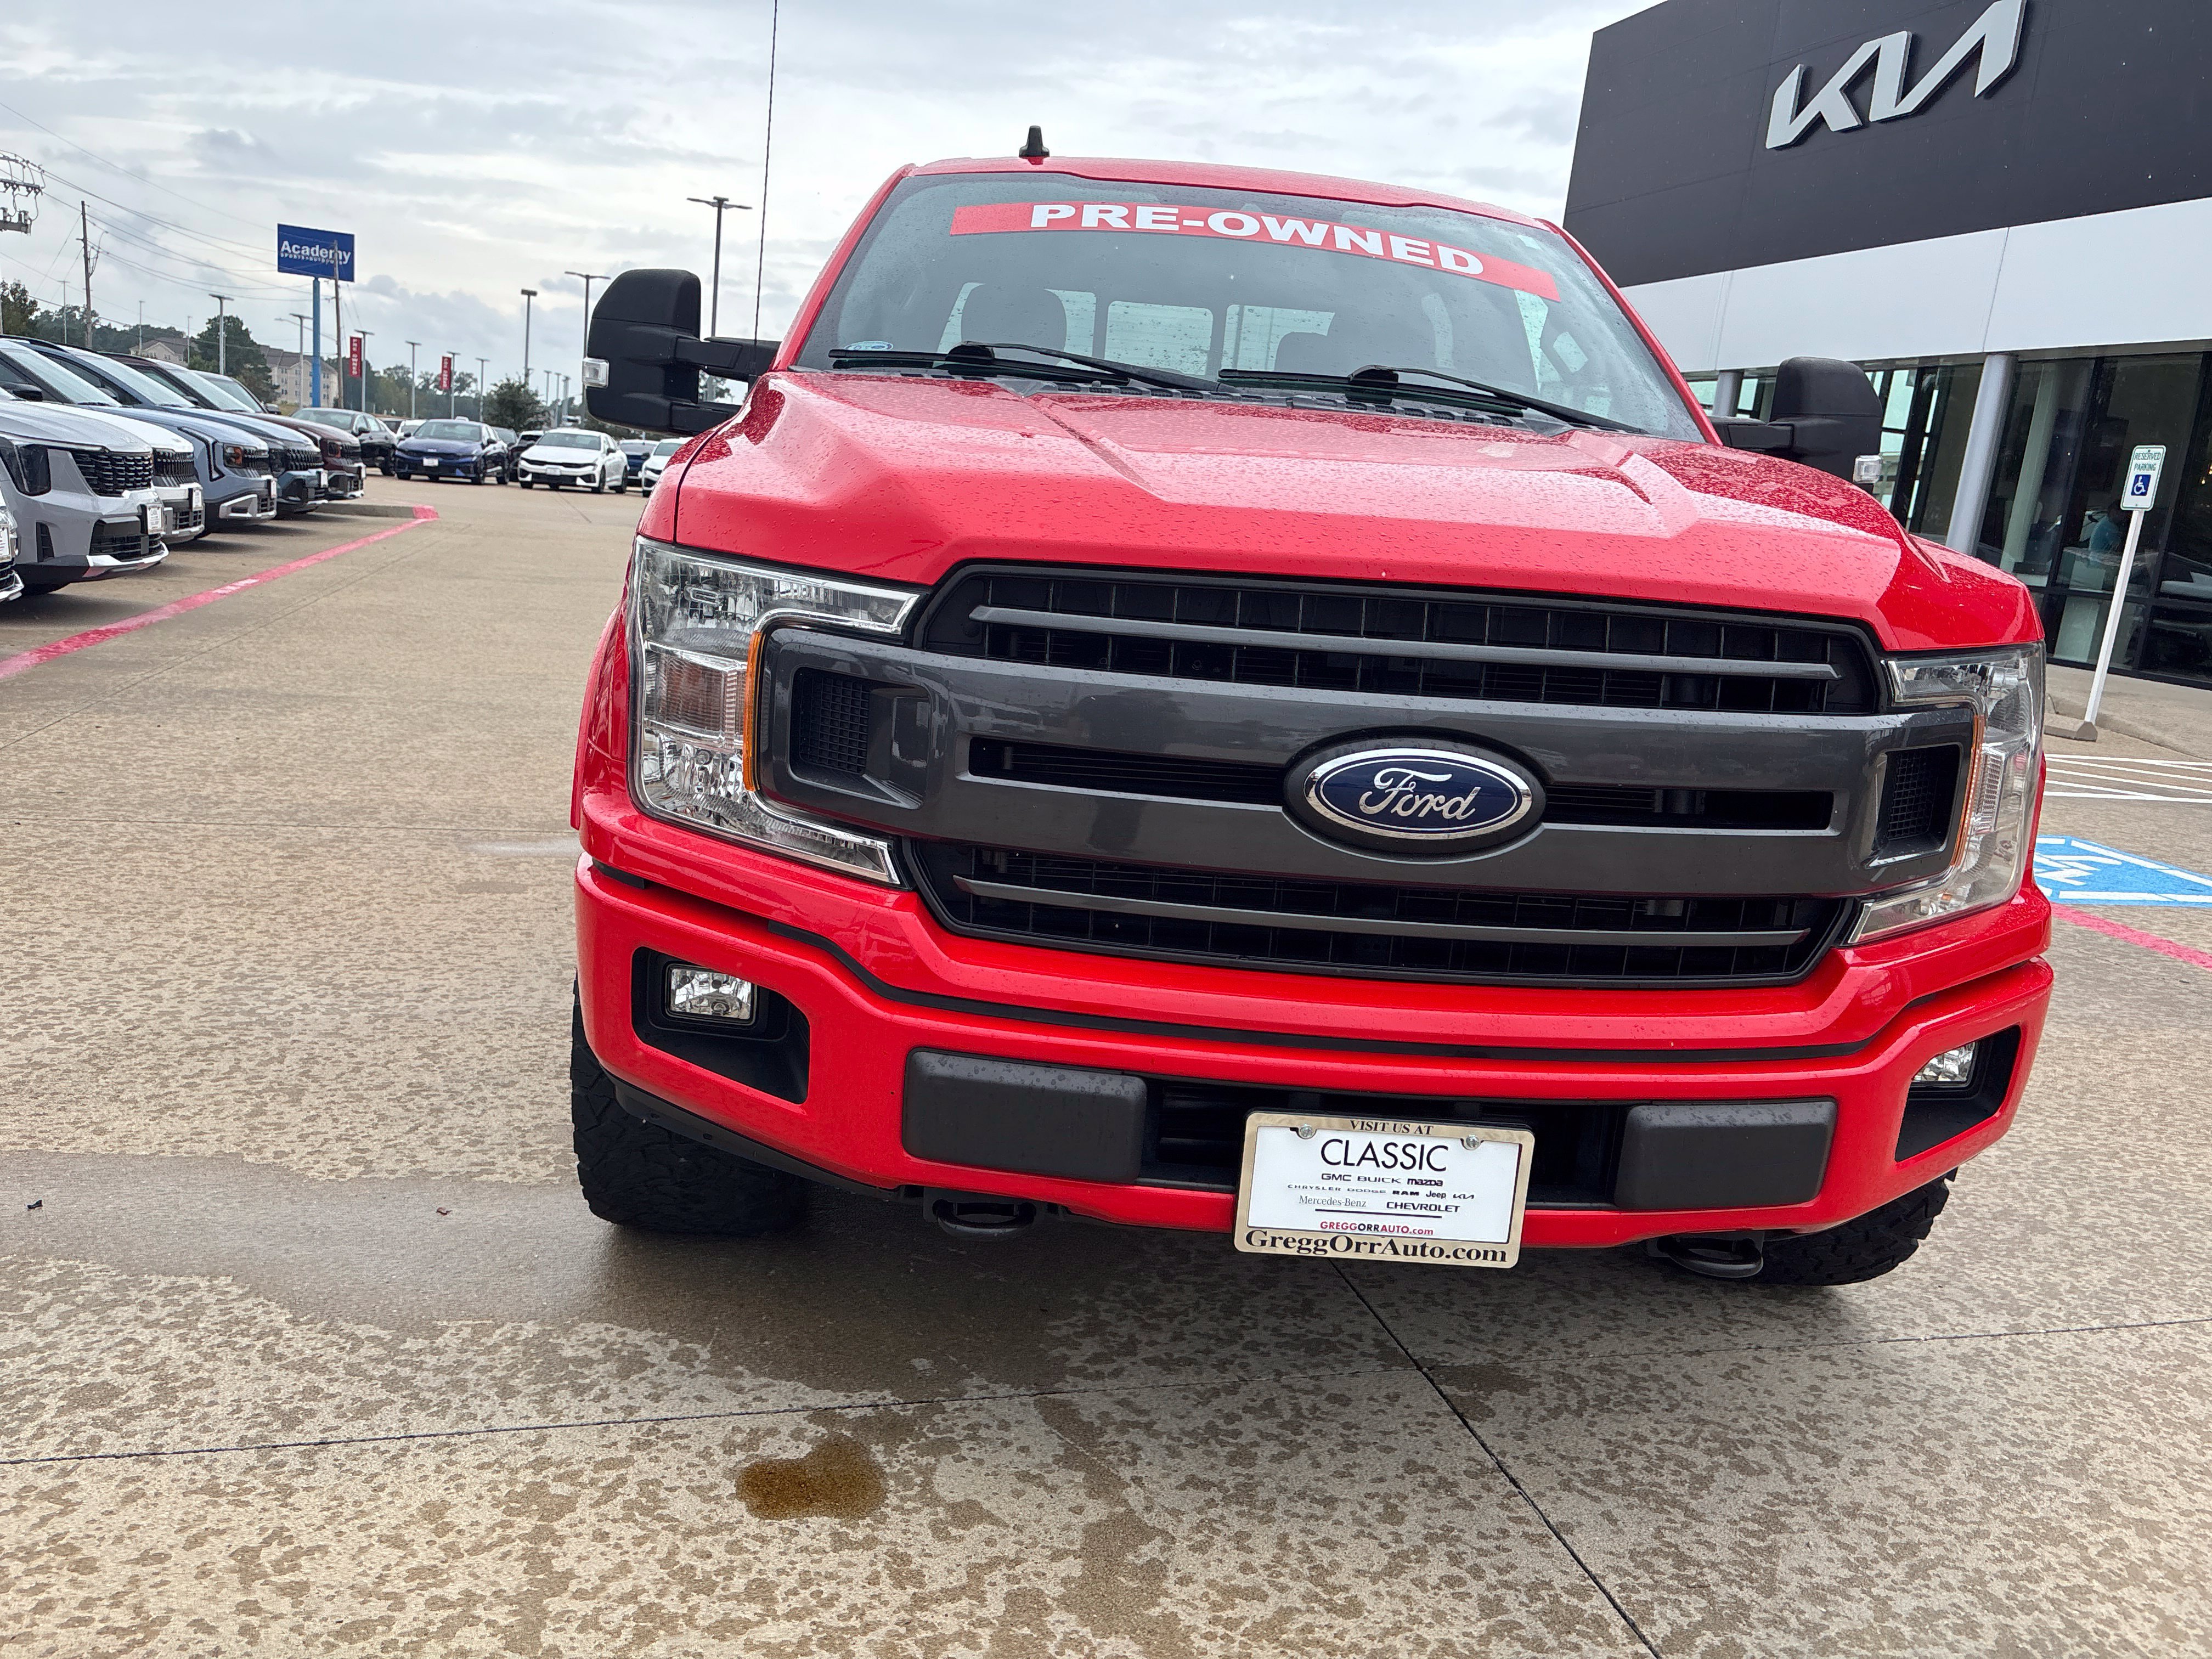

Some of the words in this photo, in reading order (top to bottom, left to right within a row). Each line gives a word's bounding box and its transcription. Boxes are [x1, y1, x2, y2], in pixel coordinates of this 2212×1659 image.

[1030, 203, 1485, 276] PRE-OWNED
[280, 240, 351, 264] Academy
[2134, 452, 2162, 460] RESERVED
[2134, 462, 2157, 471] PARKING
[1358, 768, 1481, 820] Ford
[1350, 1120, 1389, 1132] VISIT
[1391, 1122, 1412, 1133] US
[1414, 1125, 1434, 1135] AT
[1321, 1138, 1449, 1172] CLASSIC
[1321, 1173, 1352, 1182] GMC
[1357, 1176, 1402, 1184] BUICK
[1425, 1190, 1447, 1200] Jeep
[1299, 1195, 1367, 1207] Mercedes-Benz
[1386, 1201, 1461, 1213] CHEVROLET
[1320, 1221, 1434, 1235] GREGGORRAUTO.com
[1245, 1229, 1507, 1262] GreggOrrAuto.com
